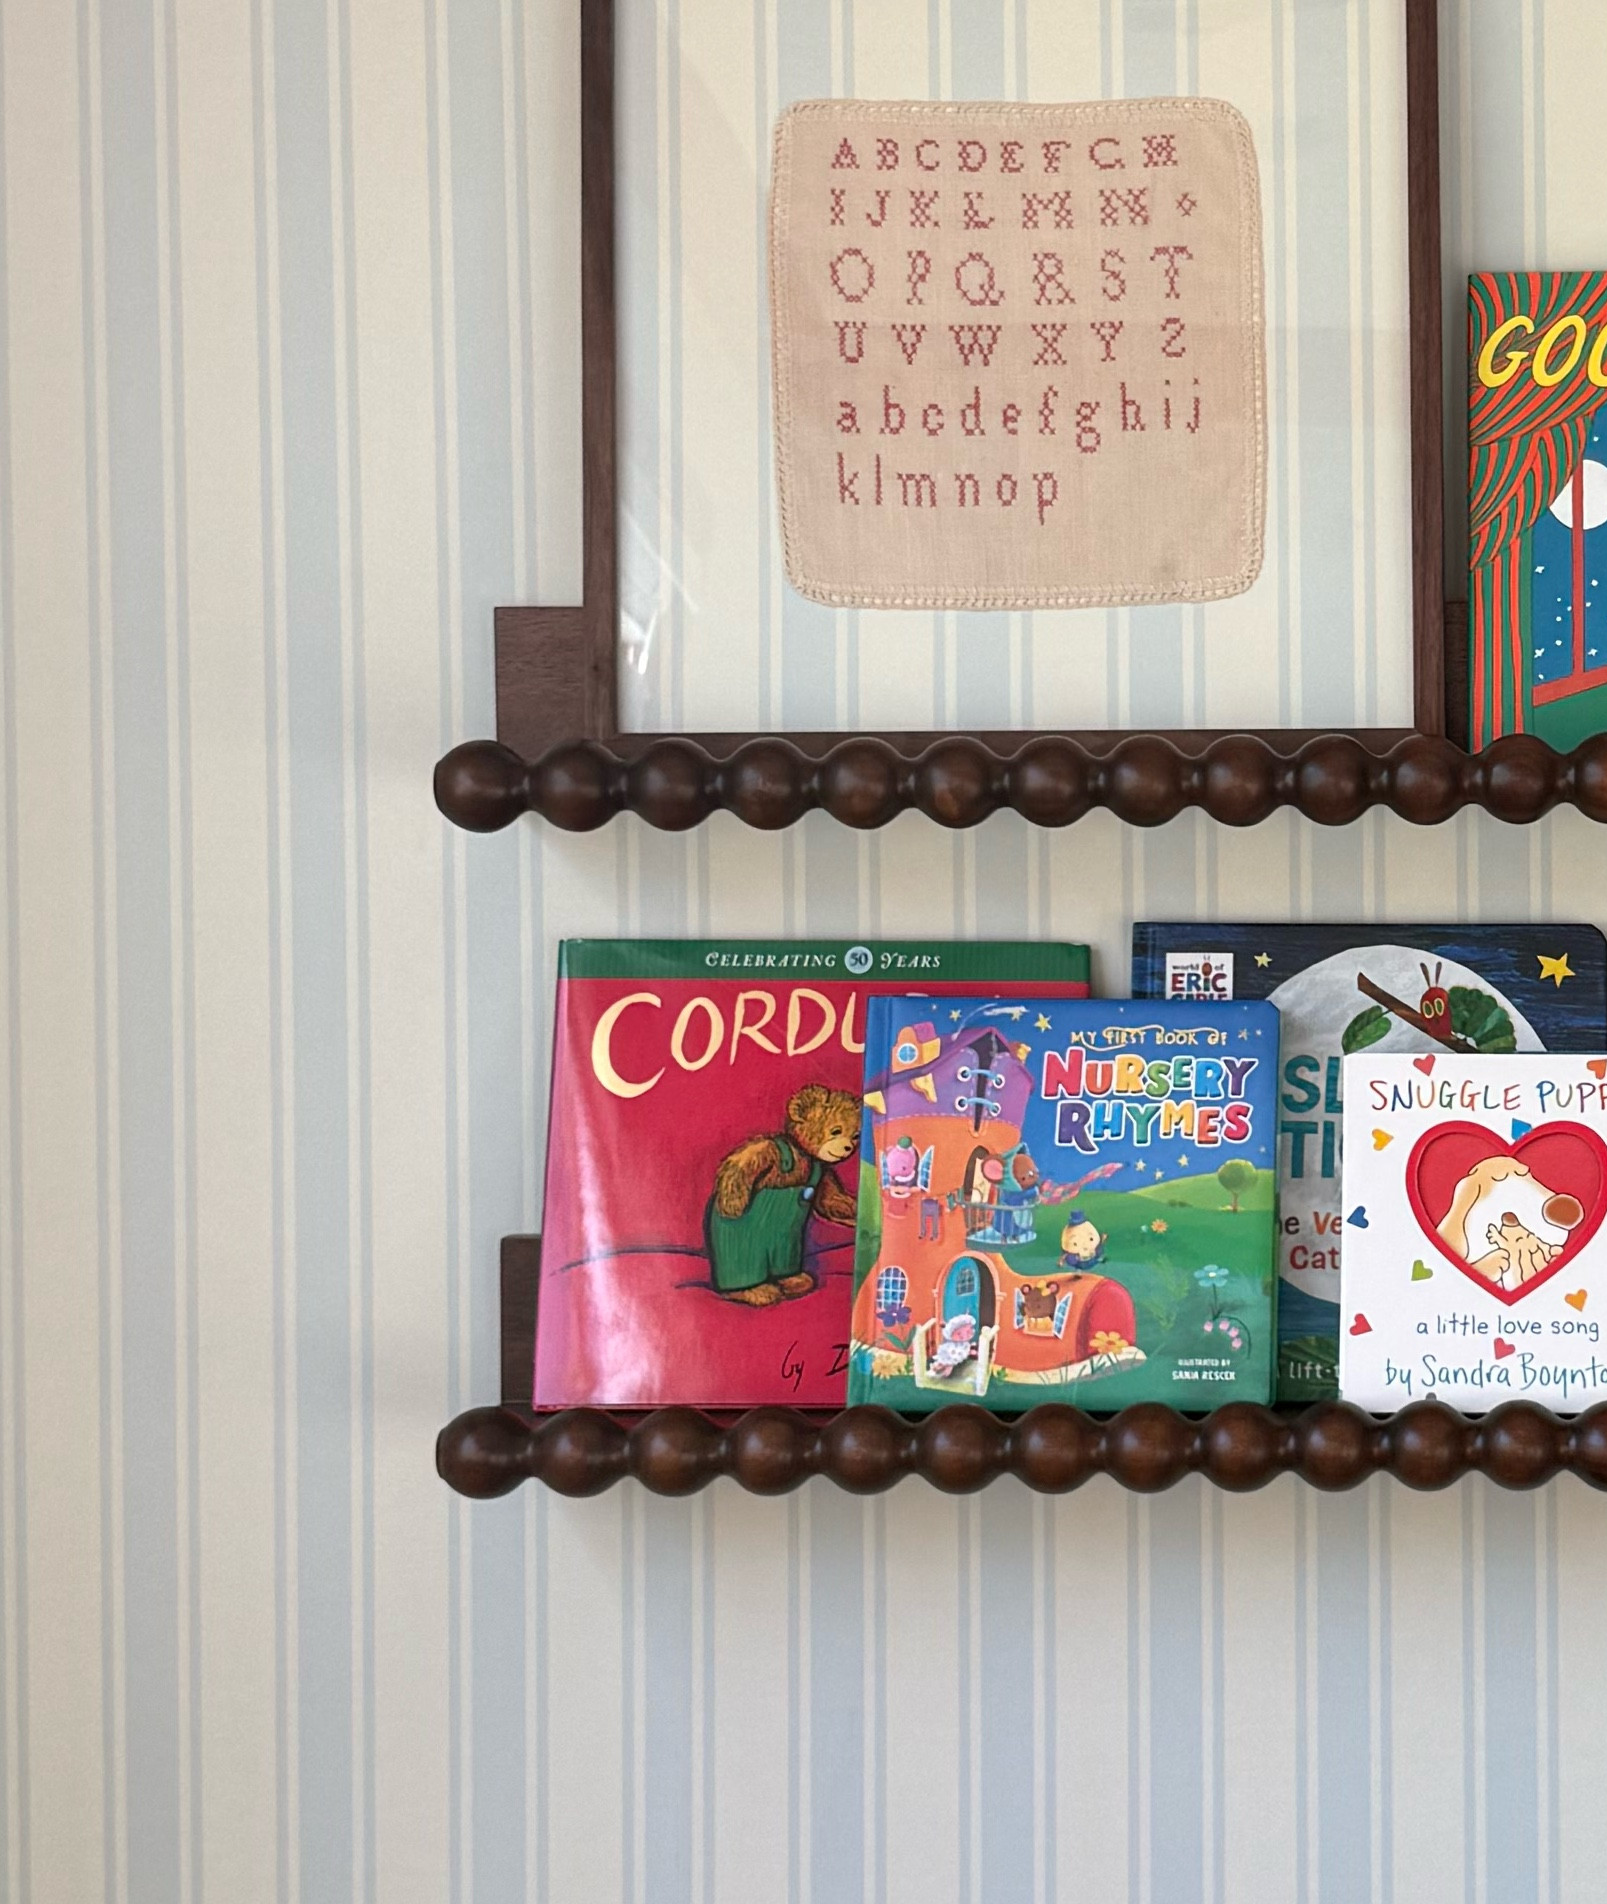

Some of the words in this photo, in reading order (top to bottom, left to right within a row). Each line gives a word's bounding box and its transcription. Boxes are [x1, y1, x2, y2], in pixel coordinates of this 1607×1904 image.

[705, 951, 836, 968] CELEBRATING
[850, 952, 869, 967] 50
[880, 951, 941, 969] YEARS
[1102, 1026, 1148, 1046] FIRST
[1155, 1029, 1200, 1046] BOOK
[1206, 1028, 1229, 1046] OF
[1042, 1047, 1258, 1100] NURSERY
[1369, 1079, 1522, 1112] SNUGGLE
[1055, 1099, 1253, 1153] RHYMES
[1289, 1244, 1340, 1271] Cat
[1416, 1321, 1429, 1335] a
[1437, 1313, 1489, 1336] little
[1498, 1315, 1543, 1335] love
[1551, 1320, 1600, 1342] song
[1385, 1358, 1412, 1396] by
[1421, 1354, 1511, 1388] Sandra
